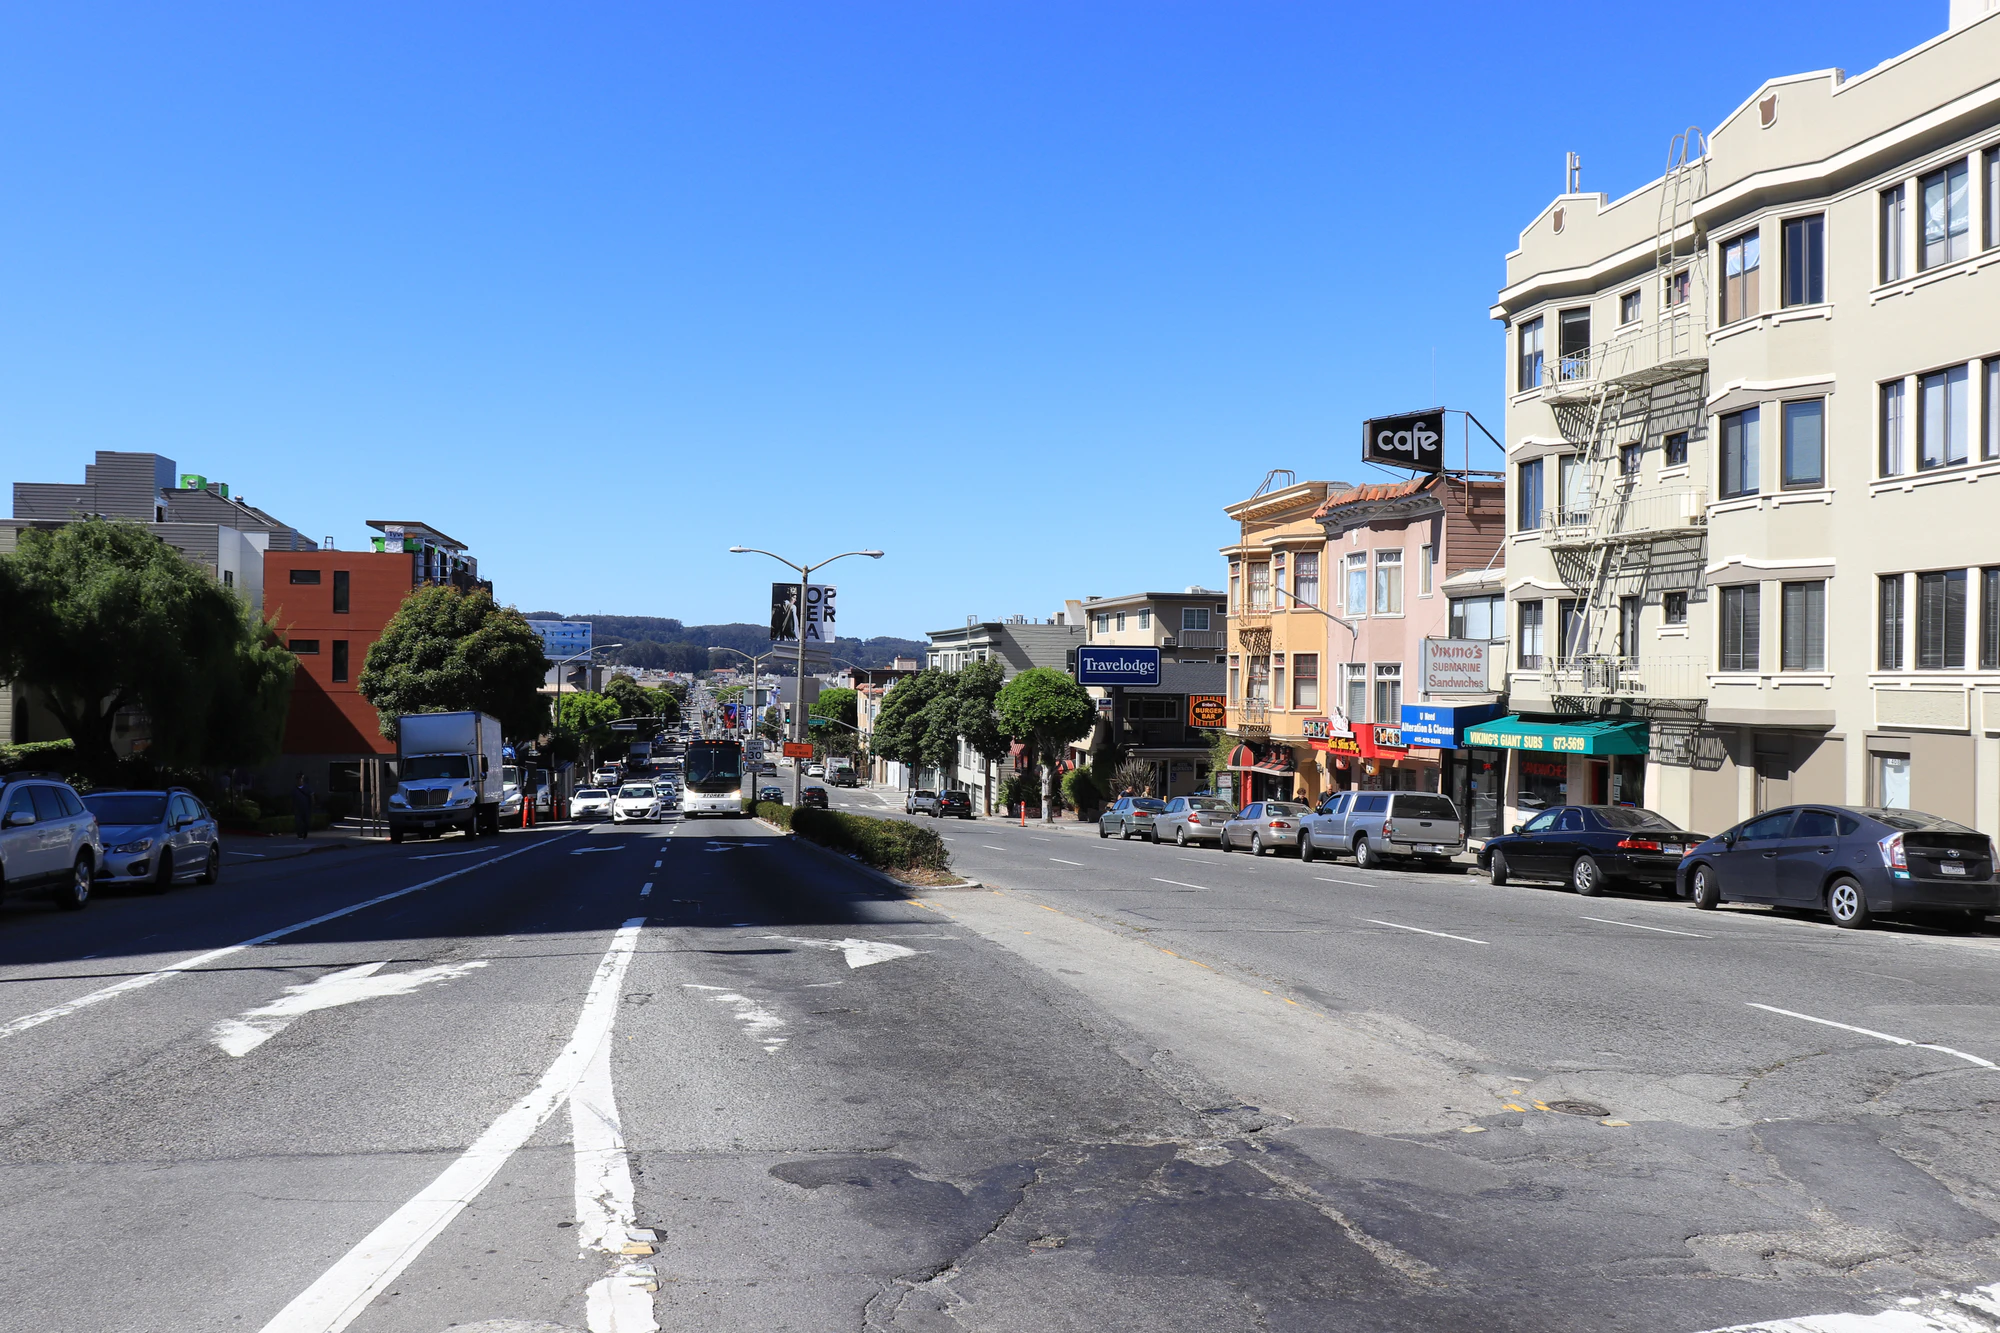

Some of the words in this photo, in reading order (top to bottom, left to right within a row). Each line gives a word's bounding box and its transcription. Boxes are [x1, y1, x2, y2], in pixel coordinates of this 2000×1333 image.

[1377, 422, 1439, 460] cafe
[1083, 657, 1155, 675] Travelodge
[1432, 662, 1481, 672] SUBMARINE
[1429, 674, 1484, 688] Sandwiches
[1424, 712, 1436, 721] Need
[1401, 722, 1428, 734] Alteration
[1433, 724, 1455, 736] Cleaner
[1470, 731, 1499, 746] VIKING'S
[1500, 734, 1522, 748] GIANT
[1523, 736, 1543, 749] SUBS
[1553, 737, 1585, 751] 673-5619
[748, 751, 762, 760] 30
